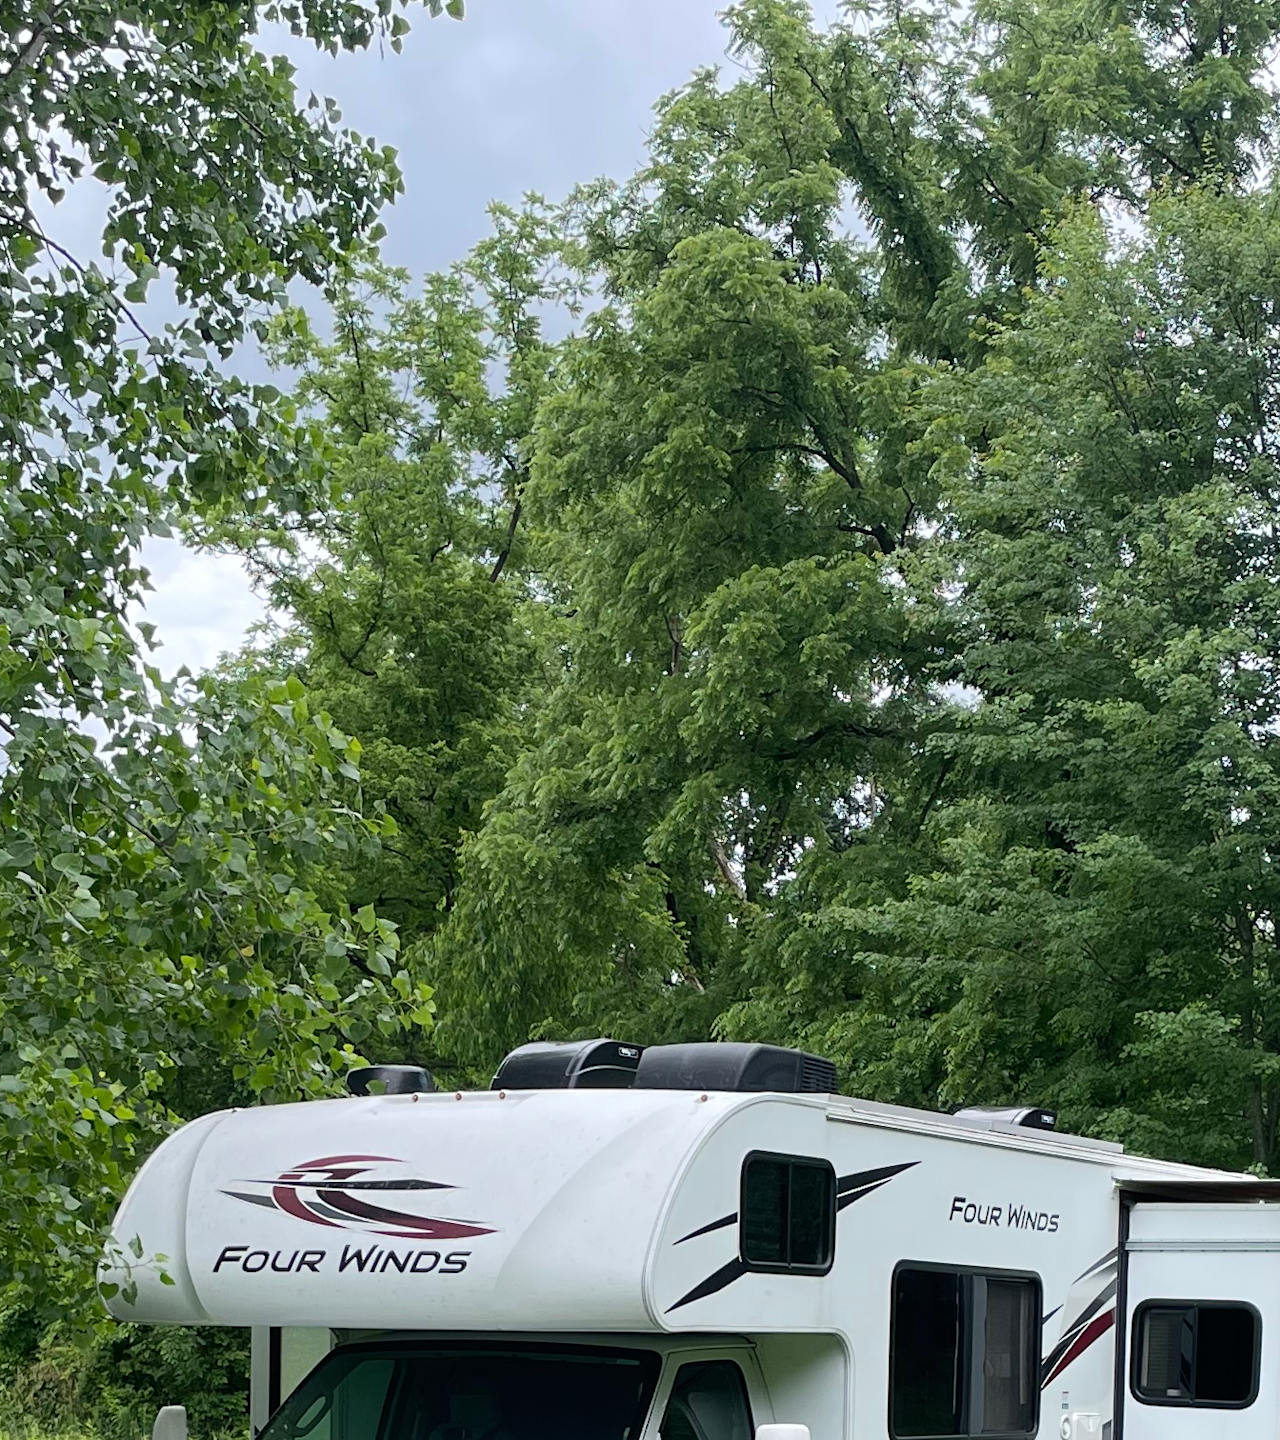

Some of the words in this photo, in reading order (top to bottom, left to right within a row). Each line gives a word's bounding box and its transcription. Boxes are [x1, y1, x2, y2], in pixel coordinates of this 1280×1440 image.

[949, 1196, 1002, 1227] FOUR
[1007, 1203, 1060, 1232] WINDS
[212, 1245, 326, 1273] FOUR
[338, 1244, 472, 1274] WINDS
